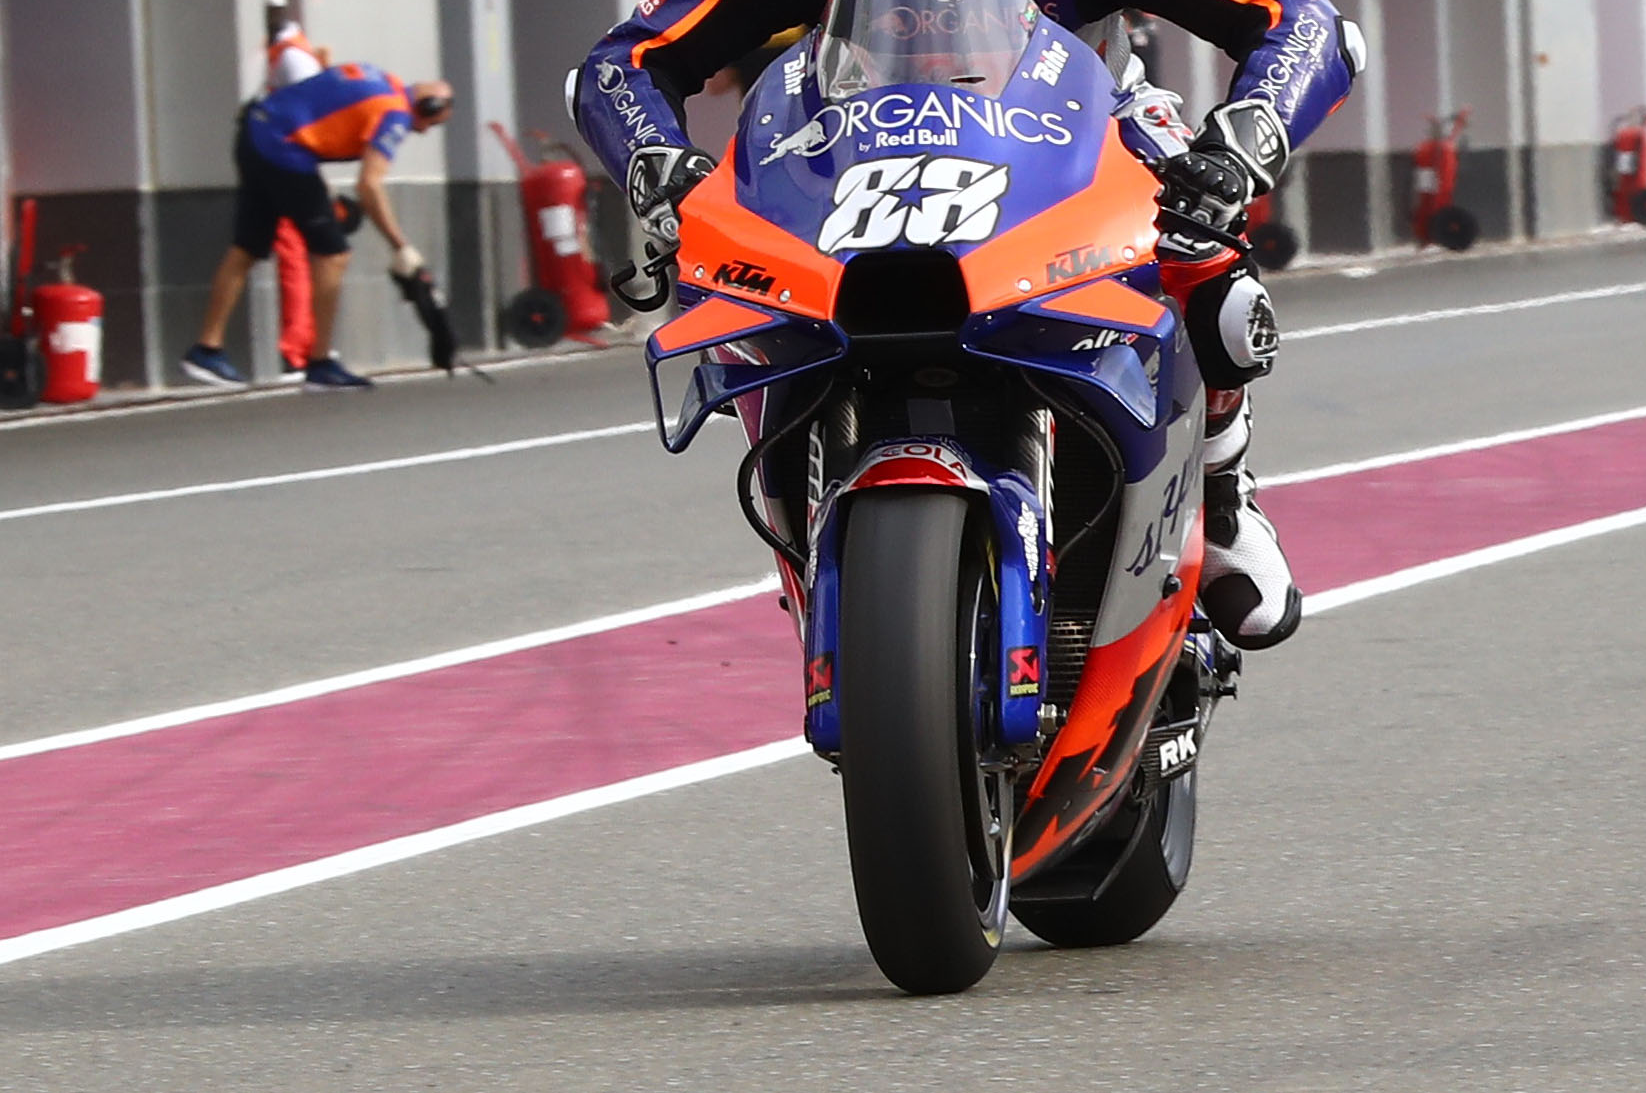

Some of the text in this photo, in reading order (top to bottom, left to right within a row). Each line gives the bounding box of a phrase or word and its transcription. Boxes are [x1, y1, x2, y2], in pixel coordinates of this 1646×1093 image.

[783, 51, 808, 97] Bihr
[1033, 40, 1072, 88] Bihr
[797, 91, 1073, 158] ORGANICS
[858, 127, 958, 153] by Red Bull
[816, 153, 1010, 255] 88
[712, 259, 776, 296] KTM
[1046, 244, 1114, 284] KTM
[880, 443, 969, 481] COLA
[1159, 727, 1198, 771] RK
